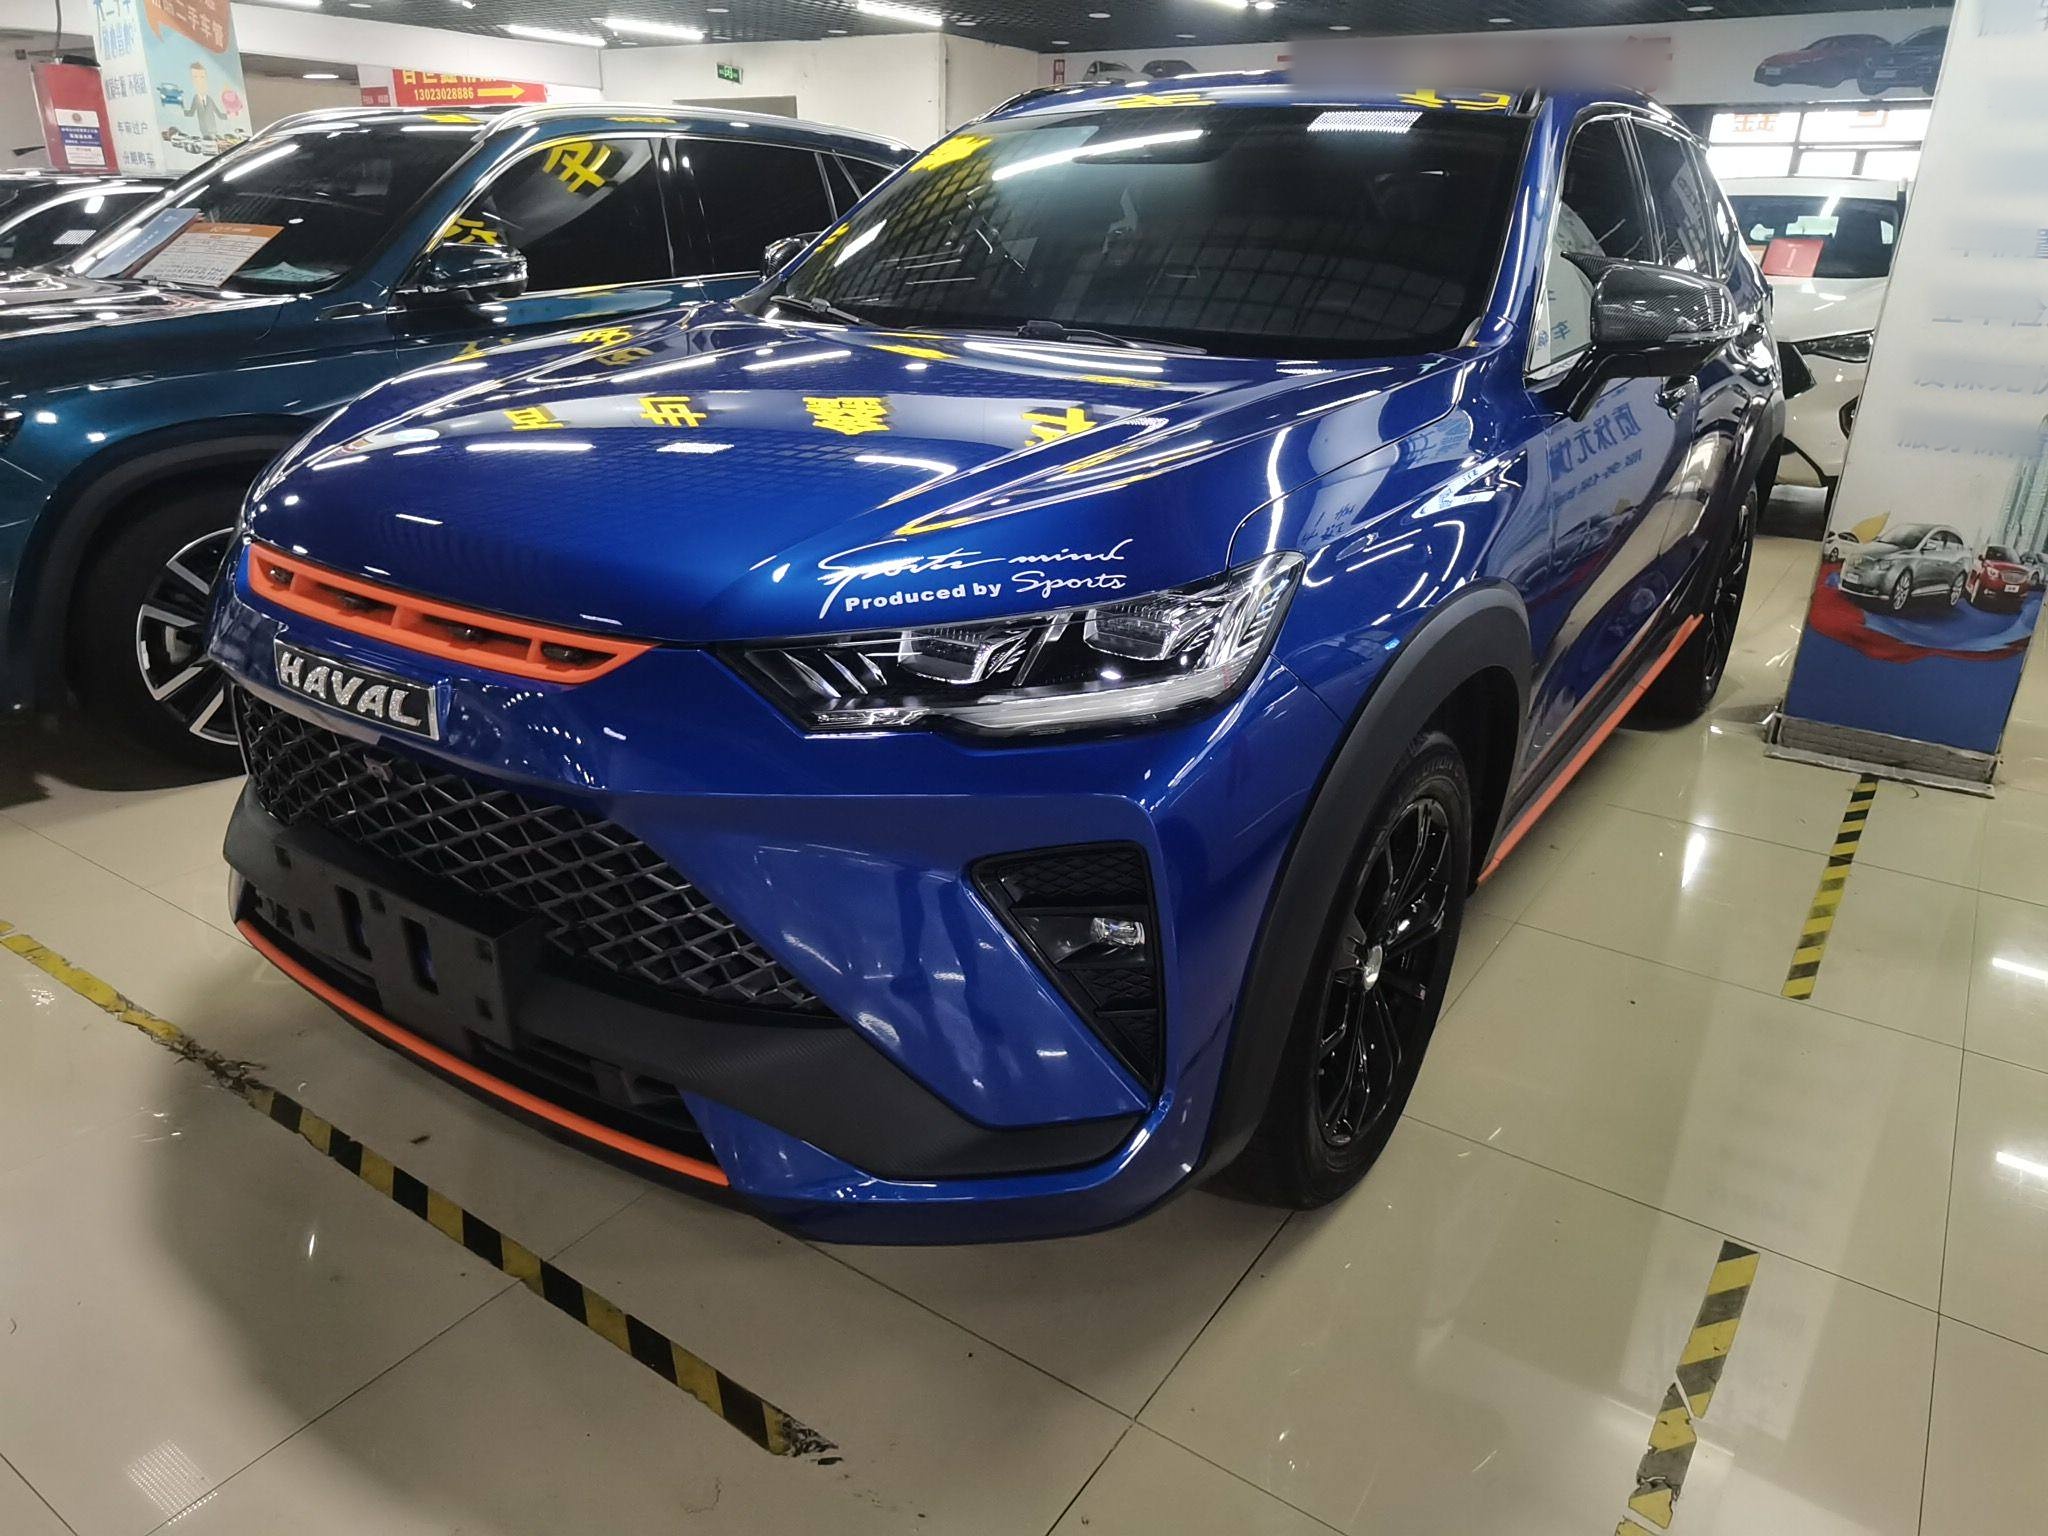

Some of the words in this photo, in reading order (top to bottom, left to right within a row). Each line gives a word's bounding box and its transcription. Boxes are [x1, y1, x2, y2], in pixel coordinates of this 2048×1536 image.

[414, 87, 474, 101] 13023028886
[1008, 539, 1133, 564] mind
[845, 584, 967, 612] Produced
[973, 582, 1002, 597] by
[1011, 570, 1127, 598] Sports
[280, 651, 422, 727] HAVAL
